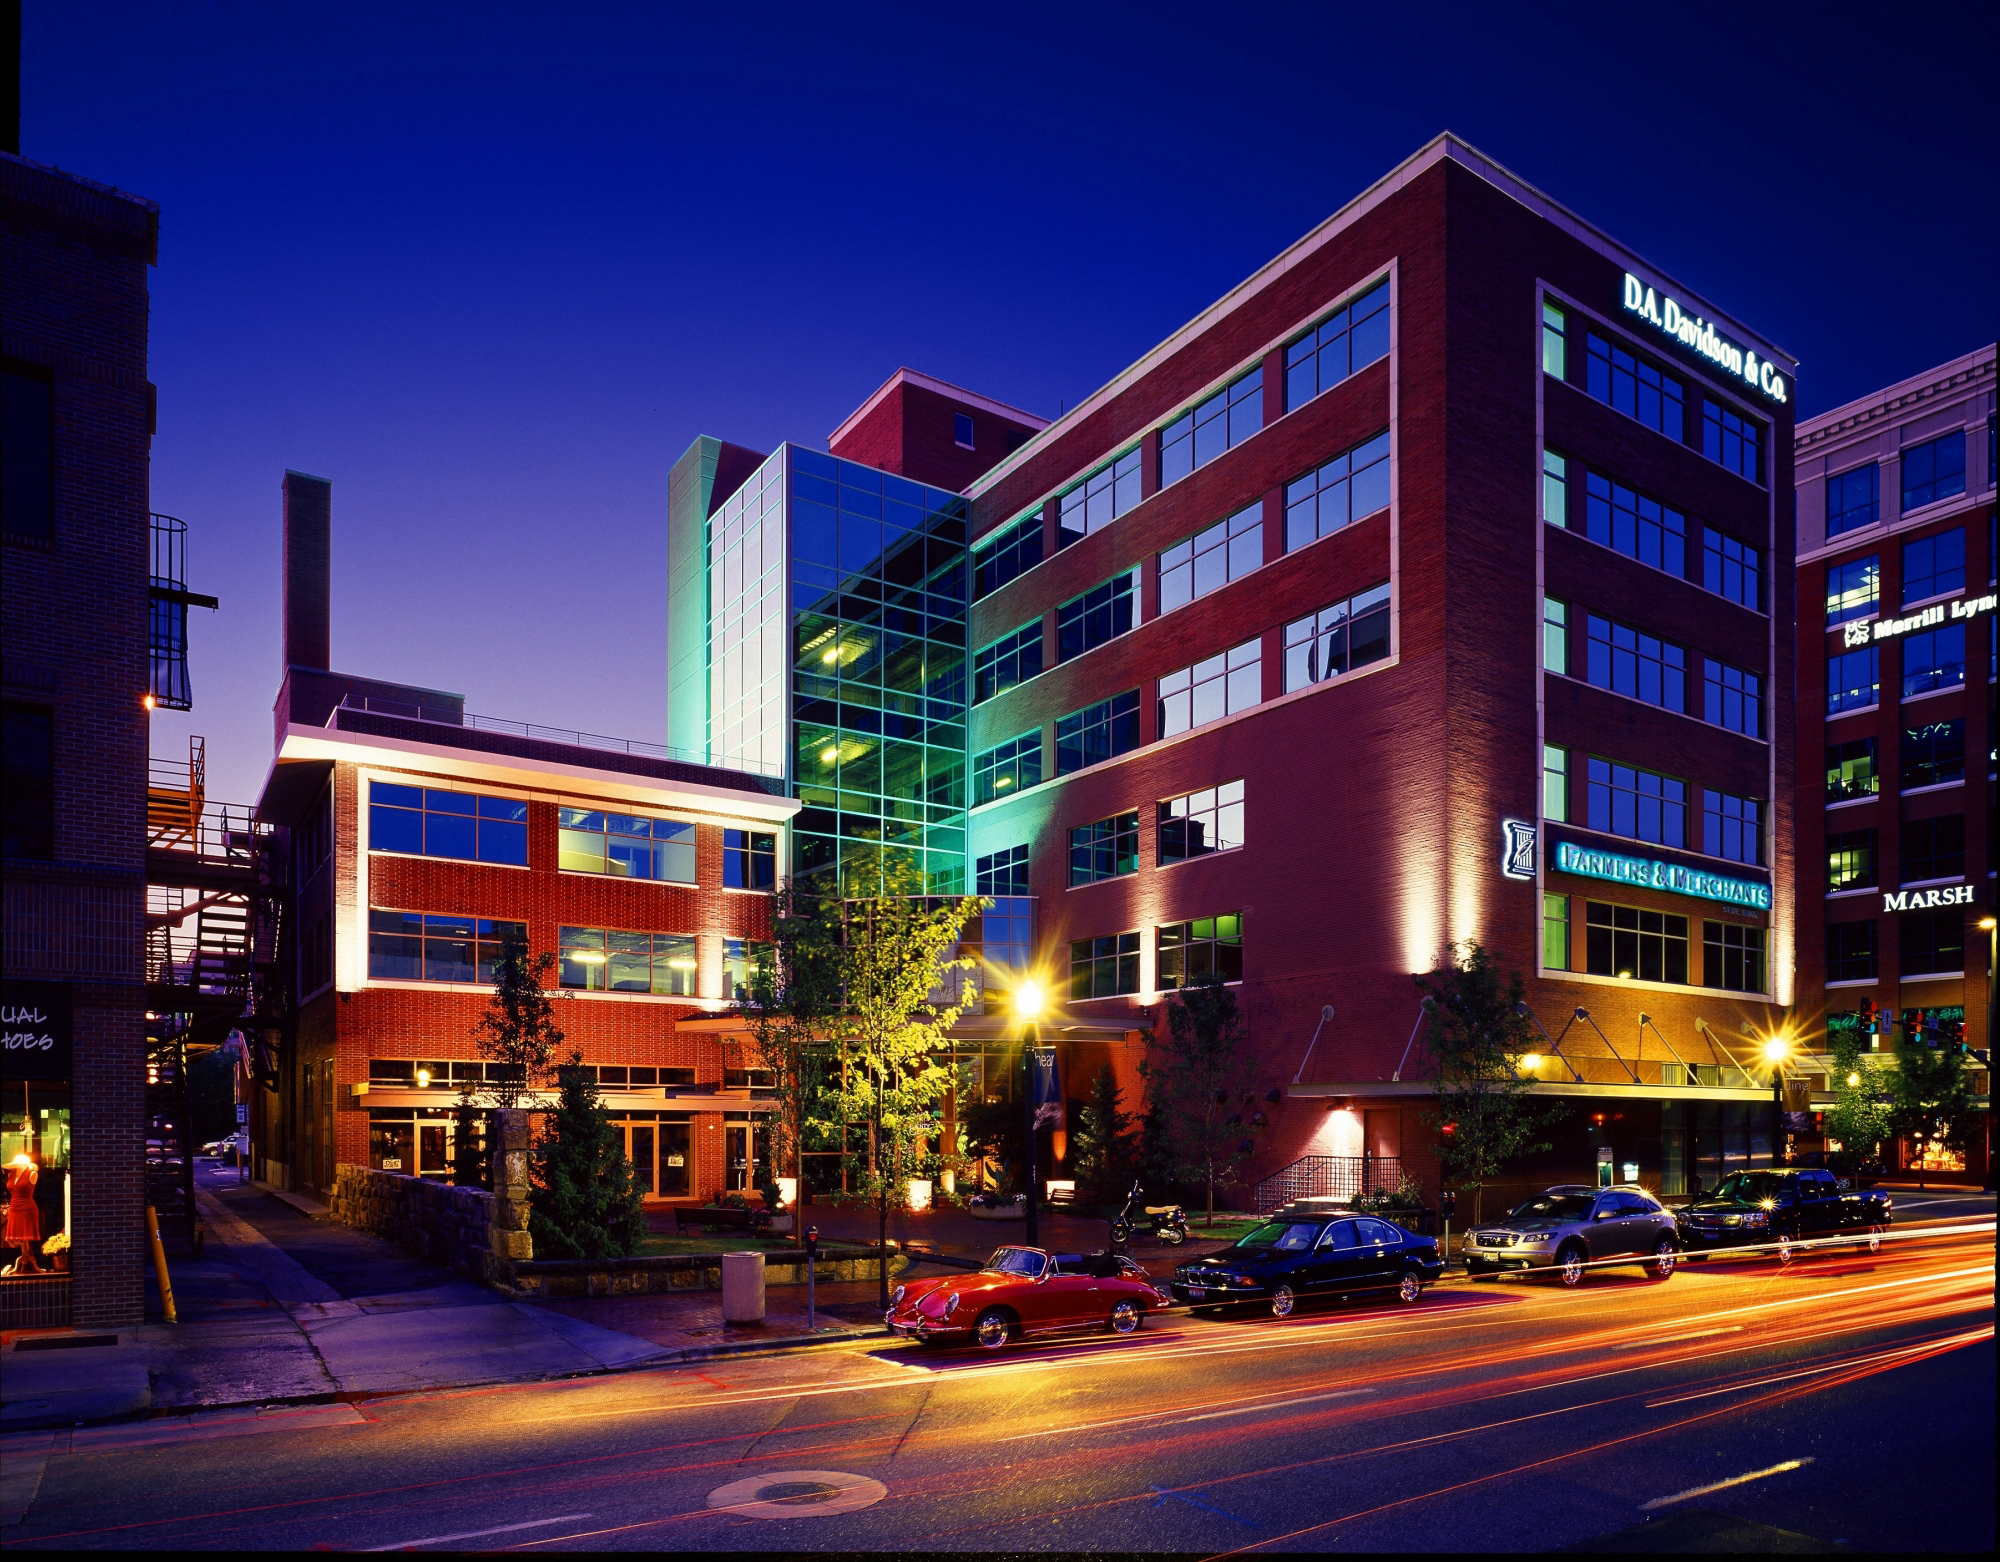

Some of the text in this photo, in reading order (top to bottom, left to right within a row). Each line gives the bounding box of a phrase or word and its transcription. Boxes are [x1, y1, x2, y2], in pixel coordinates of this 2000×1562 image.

[1664, 298, 1742, 374] Davidson
[1744, 351, 1758, 386] &
[1761, 361, 1787, 403] Co.
[1873, 605, 1944, 639] Merrill
[1564, 845, 1771, 905] FARMERS & MERCHANTS
[1883, 885, 1974, 912] MARSH
[1034, 1051, 1055, 1067] hear
[1783, 1080, 1809, 1091] dine
